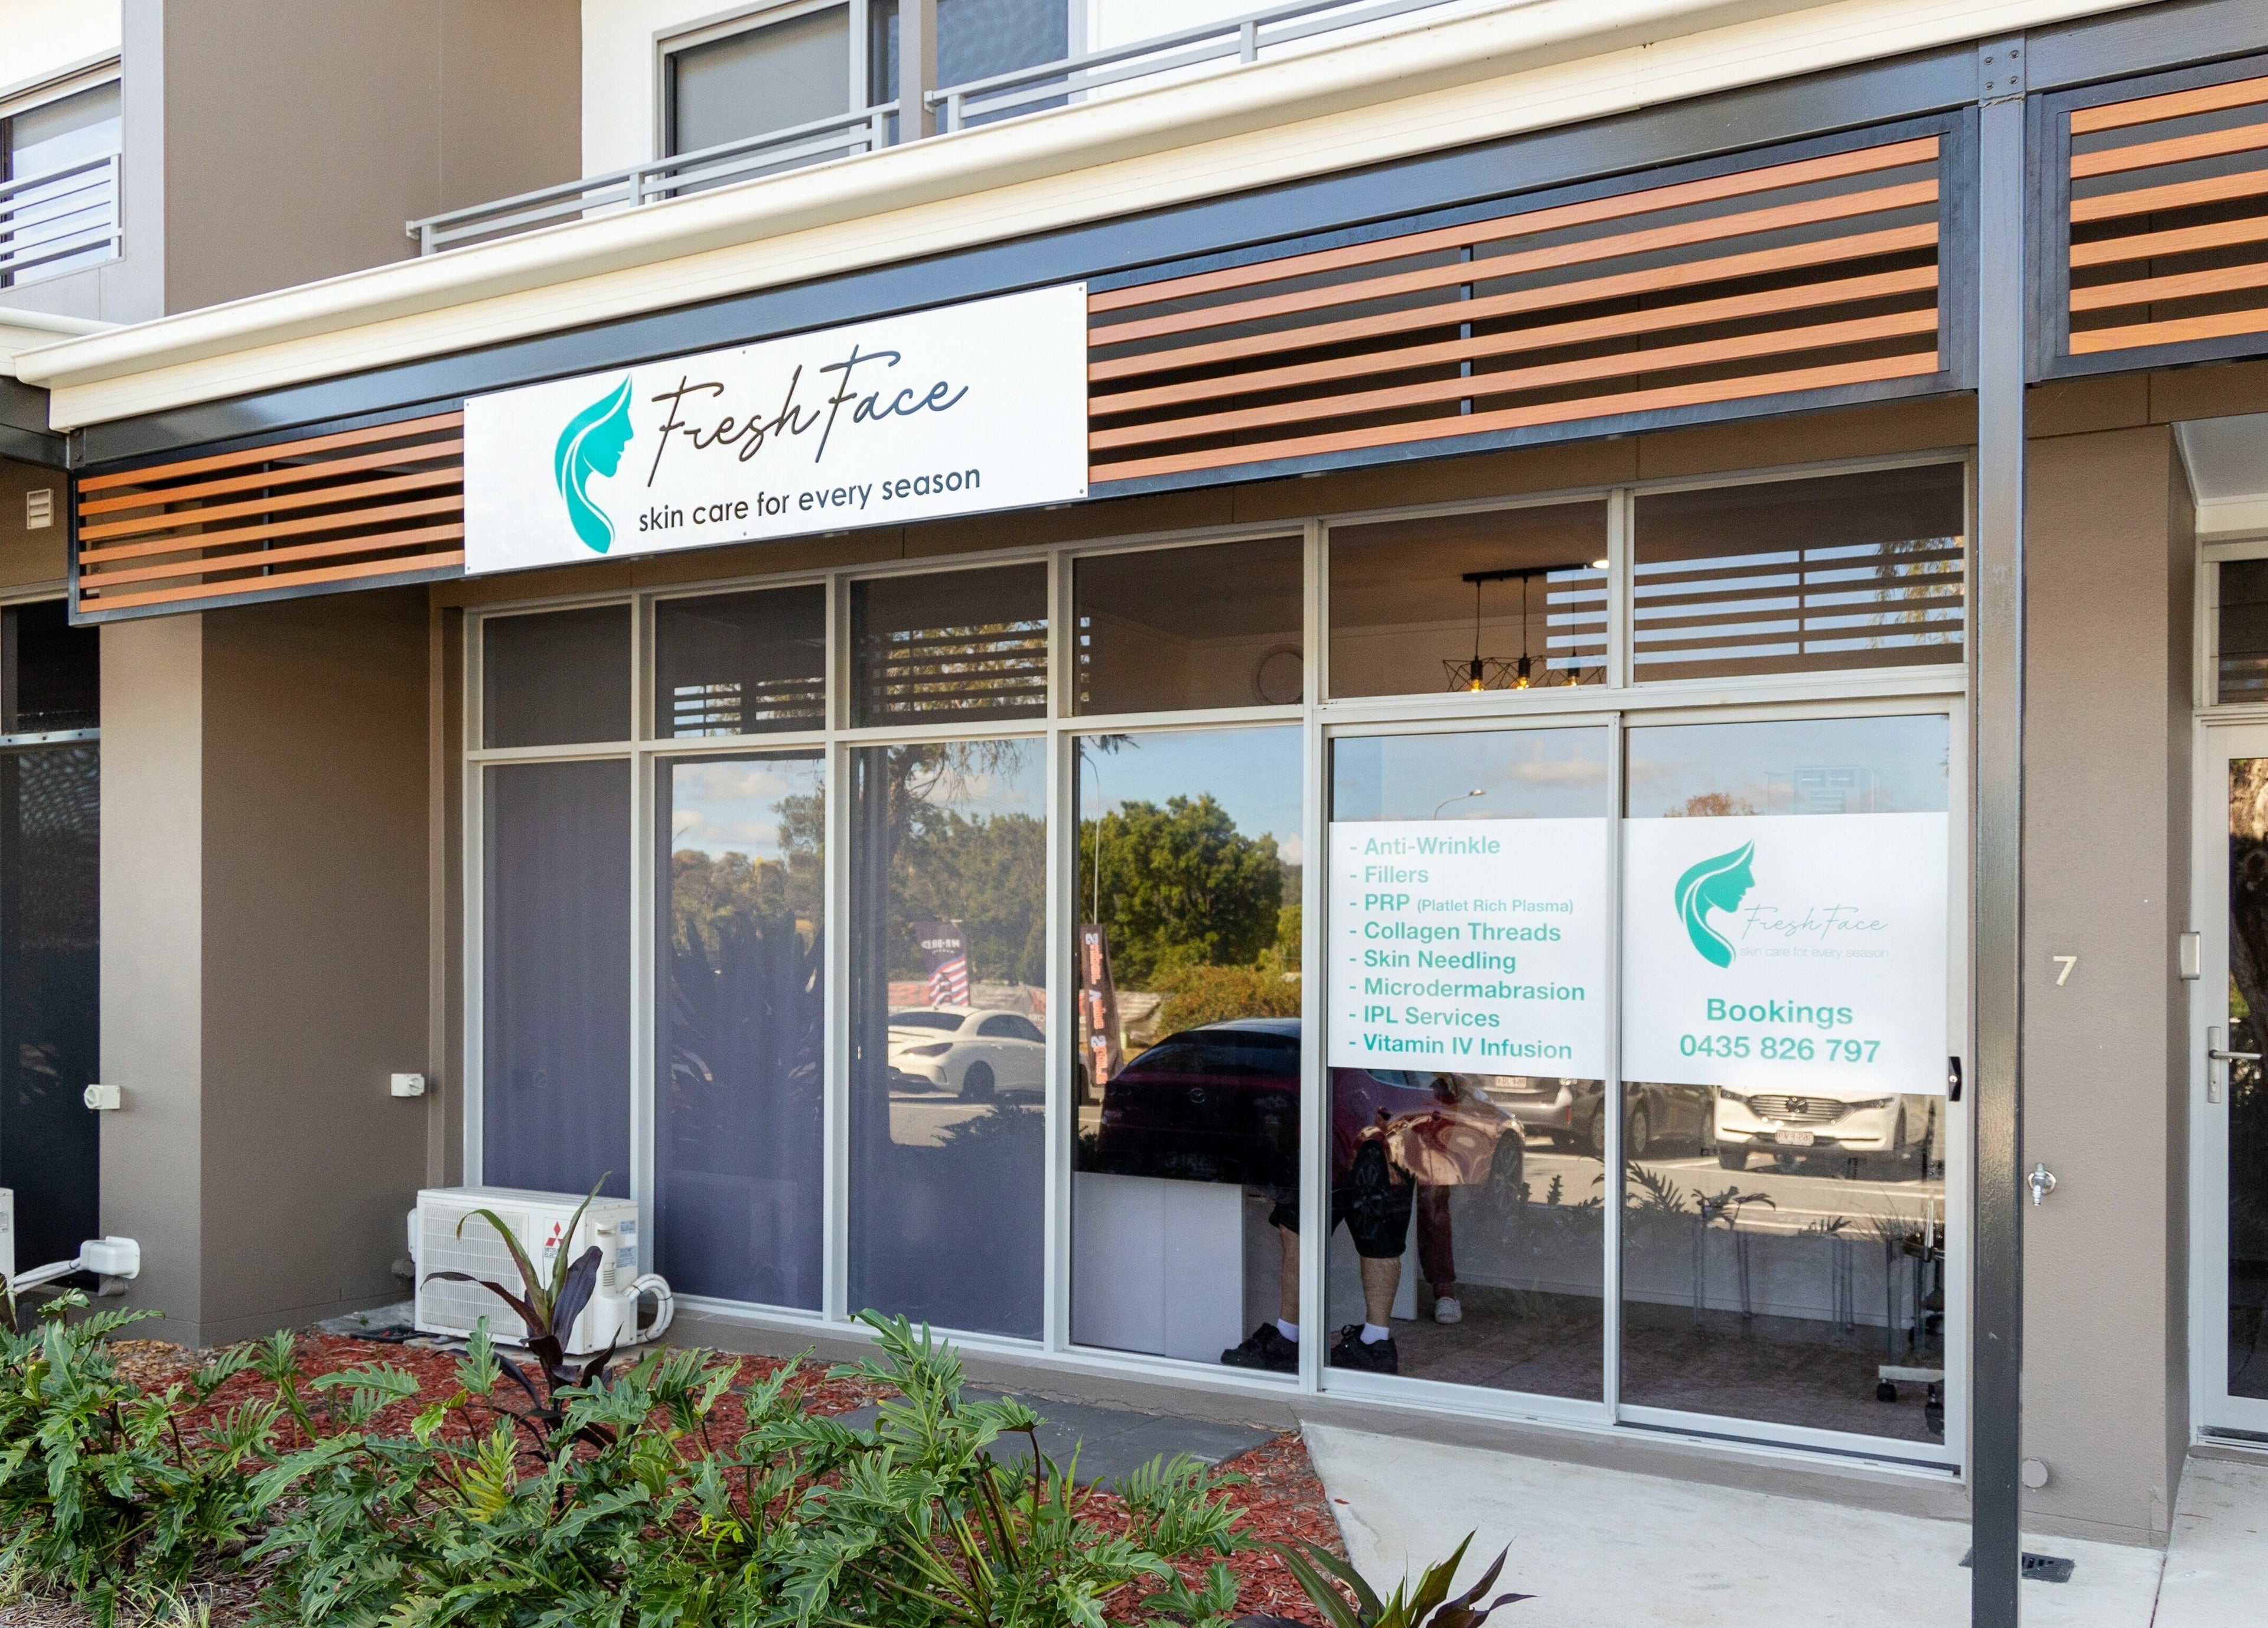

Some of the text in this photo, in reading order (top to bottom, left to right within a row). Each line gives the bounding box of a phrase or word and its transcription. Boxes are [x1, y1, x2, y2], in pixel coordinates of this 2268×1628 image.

[639, 469, 980, 532] skin care for every season
[1364, 836, 1501, 855] Anti-Wrinkle
[1364, 865, 1429, 884] Fillers
[1364, 894, 1410, 911] PRP
[1417, 899, 1469, 914] (Platlet
[1473, 899, 1507, 912] Rich
[1511, 899, 1574, 915] Plasma)
[1364, 921, 1460, 944] Collagen
[1468, 922, 1561, 942] Threads
[1364, 949, 1410, 968] Skin
[1418, 950, 1516, 973] Needling
[1739, 945, 1889, 960] skin care for every season
[2053, 956, 2077, 986] 7
[1364, 978, 1585, 1001] Microdermabrasion
[1364, 1005, 1399, 1024] IPL
[1405, 1007, 1501, 1028] Services
[1707, 998, 1853, 1029] Bookings
[1363, 1034, 1444, 1054] Vitamin
[1452, 1037, 1473, 1055] IV
[1480, 1037, 1572, 1059] Infusion
[1680, 1034, 1881, 1063] 0435 826 797
